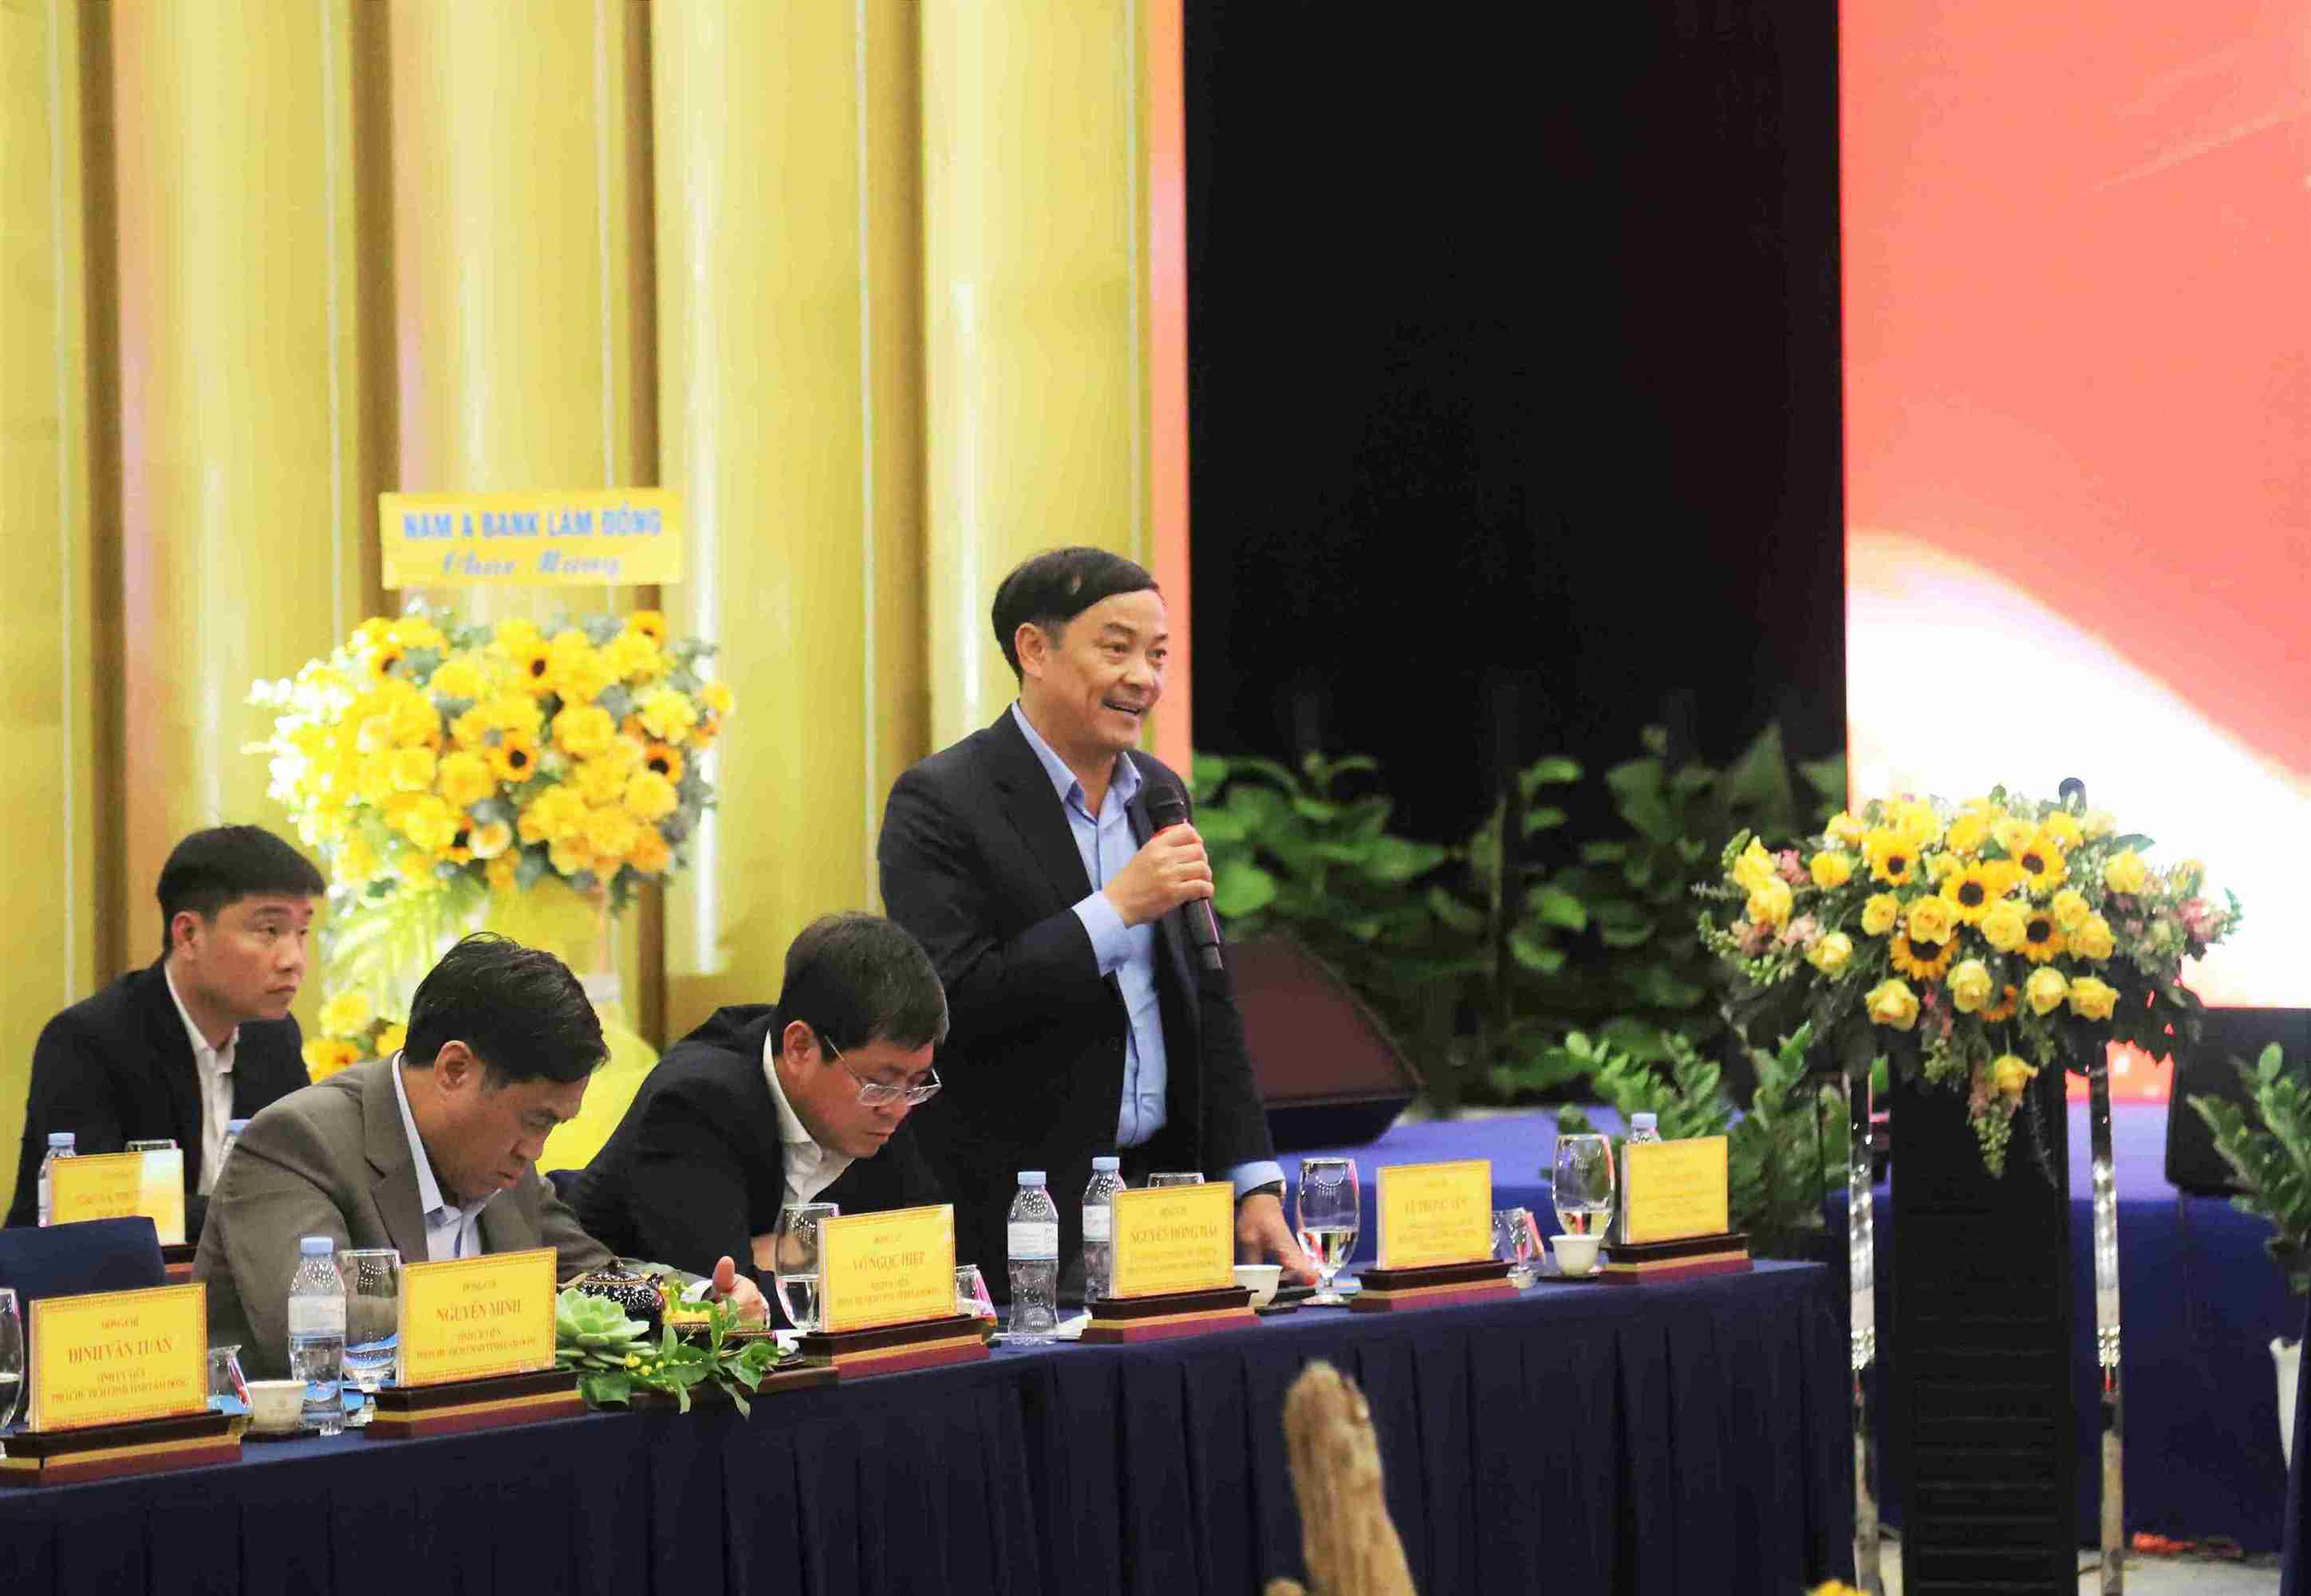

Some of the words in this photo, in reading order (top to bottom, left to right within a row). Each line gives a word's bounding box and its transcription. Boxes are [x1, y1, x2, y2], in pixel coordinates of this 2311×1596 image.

[404, 512, 452, 538] NAM
[482, 509, 538, 537] BANK
[490, 1296, 523, 1316] MINH
[105, 1339, 132, 1359] VĂN
